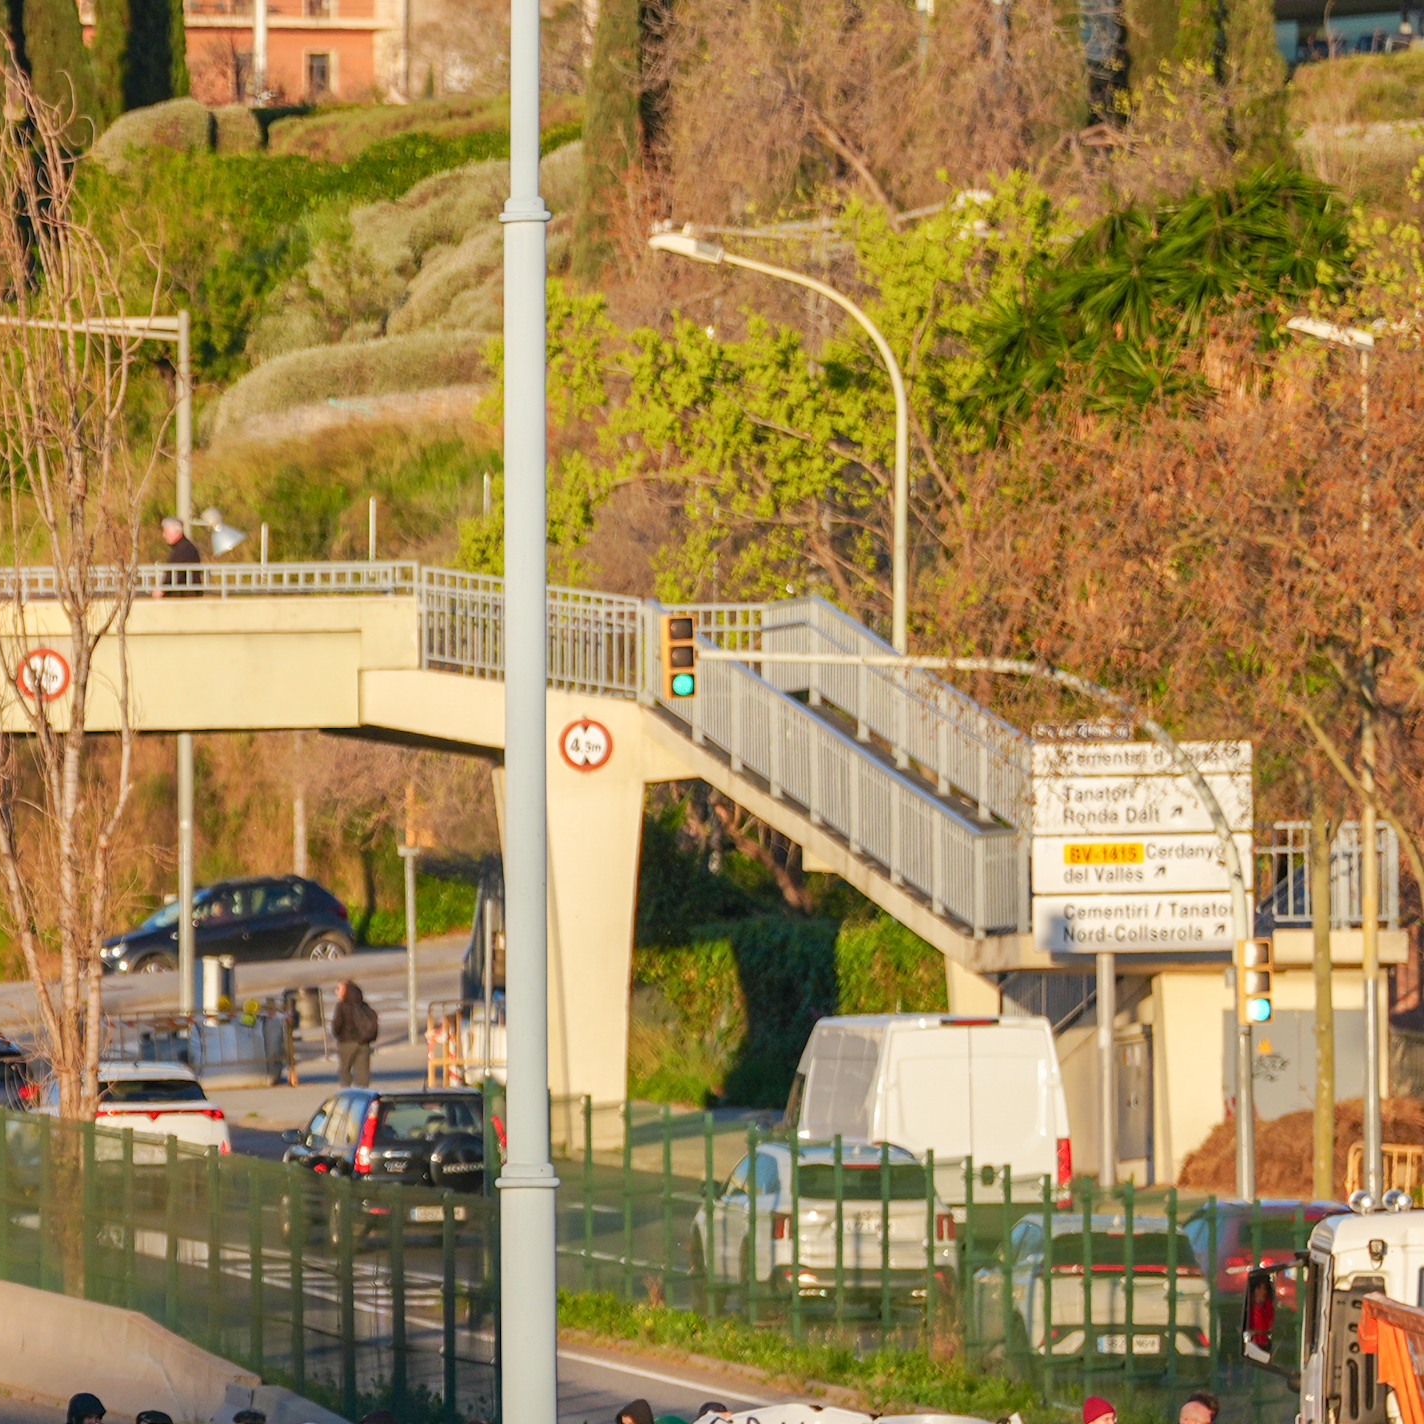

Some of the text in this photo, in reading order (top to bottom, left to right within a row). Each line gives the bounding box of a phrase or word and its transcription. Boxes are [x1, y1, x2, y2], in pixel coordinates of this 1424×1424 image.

[1063, 784, 1135, 801] Tanatori
[1063, 804, 1161, 824] Ronda Dalt
[1069, 846, 1138, 863] BV-1415
[1063, 866, 1145, 884] del Vallès
[1063, 902, 1149, 920] Cementiri
[1154, 902, 1163, 919] /
[1063, 924, 1204, 943] Nord-Collserola
